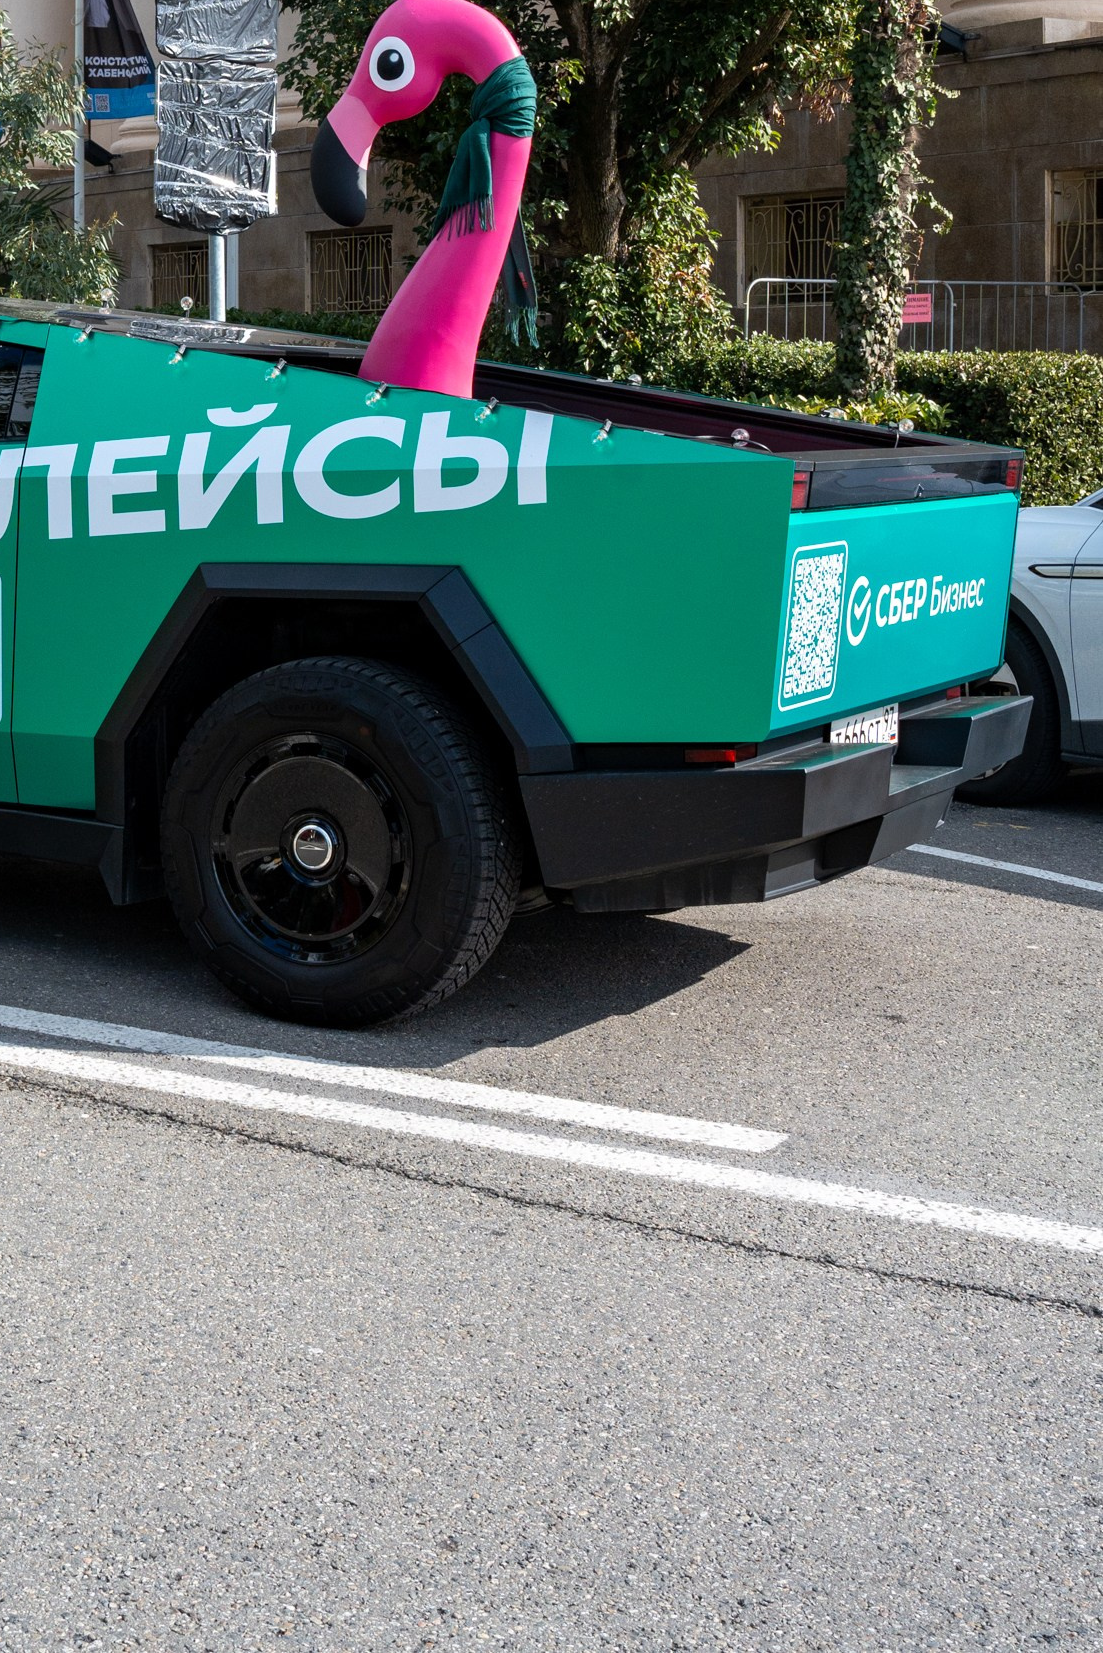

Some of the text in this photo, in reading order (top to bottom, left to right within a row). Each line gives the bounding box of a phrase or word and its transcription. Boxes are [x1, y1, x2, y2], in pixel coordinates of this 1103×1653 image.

[85, 55, 148, 66] КОНСТАТИН
[875, 575, 985, 628] СБЕР Бизнес
